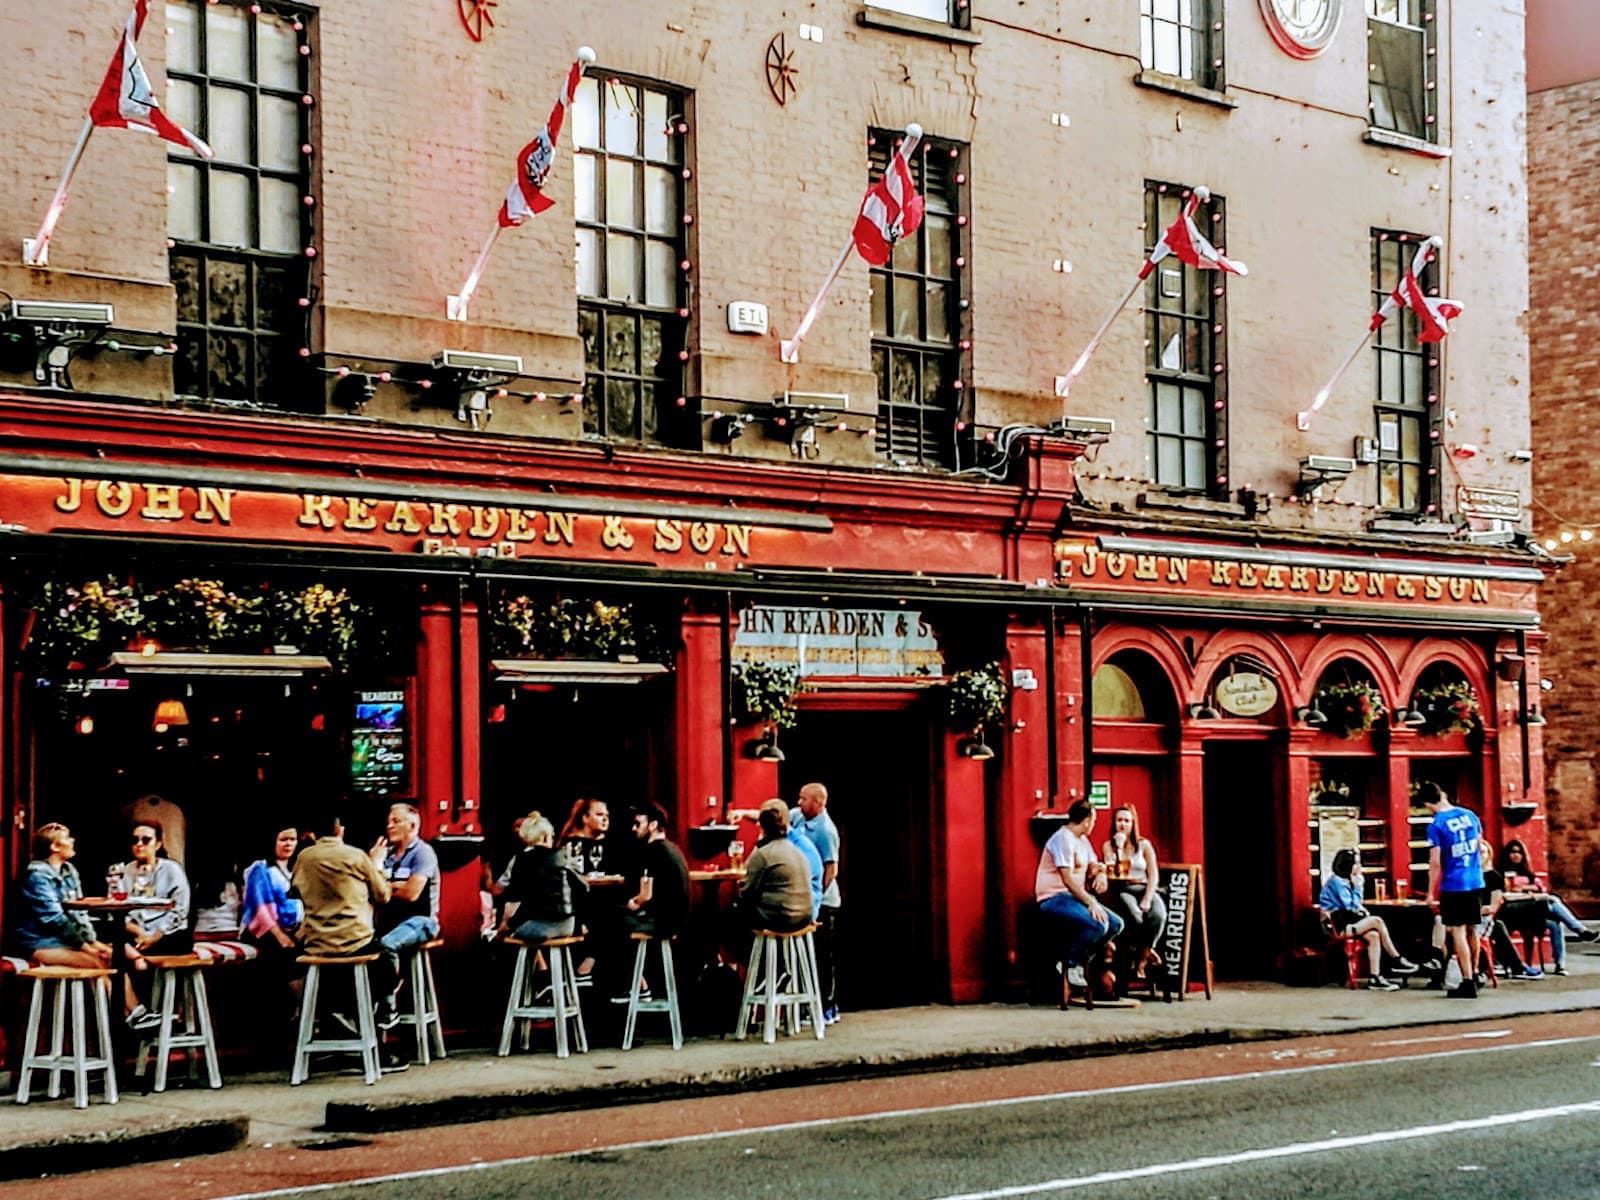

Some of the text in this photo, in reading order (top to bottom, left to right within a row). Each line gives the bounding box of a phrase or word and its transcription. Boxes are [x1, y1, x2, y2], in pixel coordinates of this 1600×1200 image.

[738, 307, 765, 324] ETL
[55, 477, 752, 557] JOHN REARDEN & SON
[1081, 544, 1489, 603] JOHN REARDEN & SON
[783, 608, 885, 637] REARDEN
[895, 612, 908, 638] &
